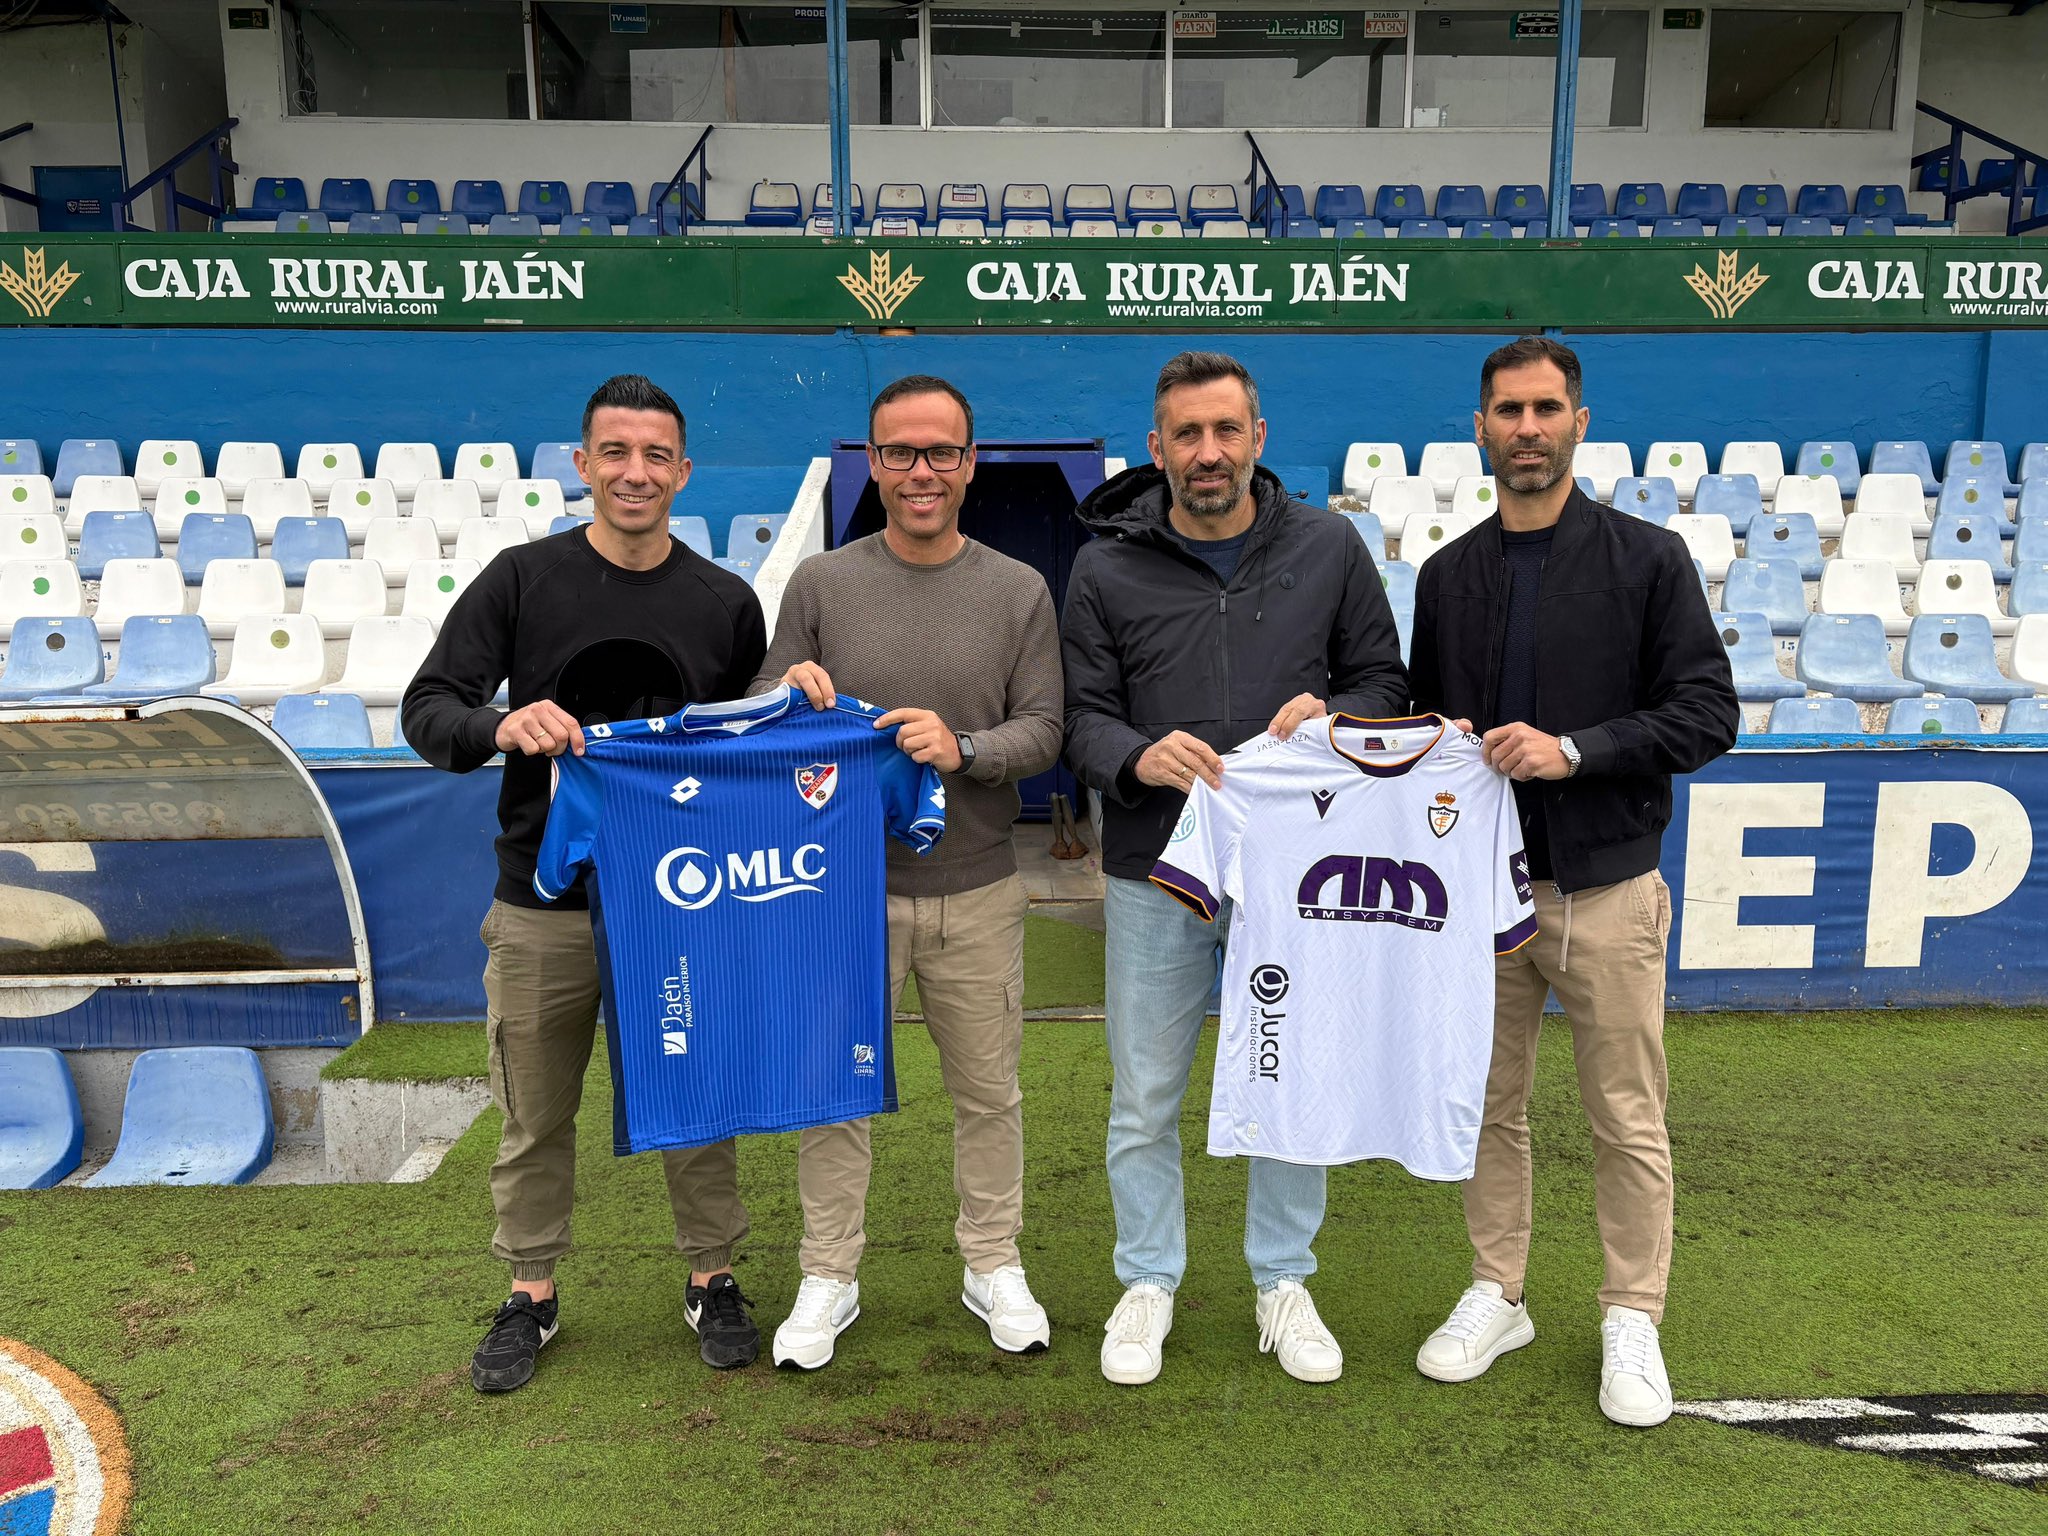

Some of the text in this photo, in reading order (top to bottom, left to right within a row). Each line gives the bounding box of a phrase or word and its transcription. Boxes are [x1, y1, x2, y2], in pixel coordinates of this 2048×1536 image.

[611, 14, 622, 22] TV
[124, 250, 585, 303] CAJA RURAL JAÉN
[966, 254, 1410, 305] CAJA RURAL JAÉN
[1807, 260, 2048, 303] CAJA RUR
[275, 299, 438, 316] www.ruralvia.com
[1107, 302, 1264, 318] www.ruralvia.com
[726, 843, 827, 891] MLC
[658, 976, 686, 1030] Jaén
[680, 955, 694, 1028] PARAÍSO INTERIOR
[1248, 1005, 1260, 1083] Instalaciones
[1259, 1007, 1287, 1083] Jucar
